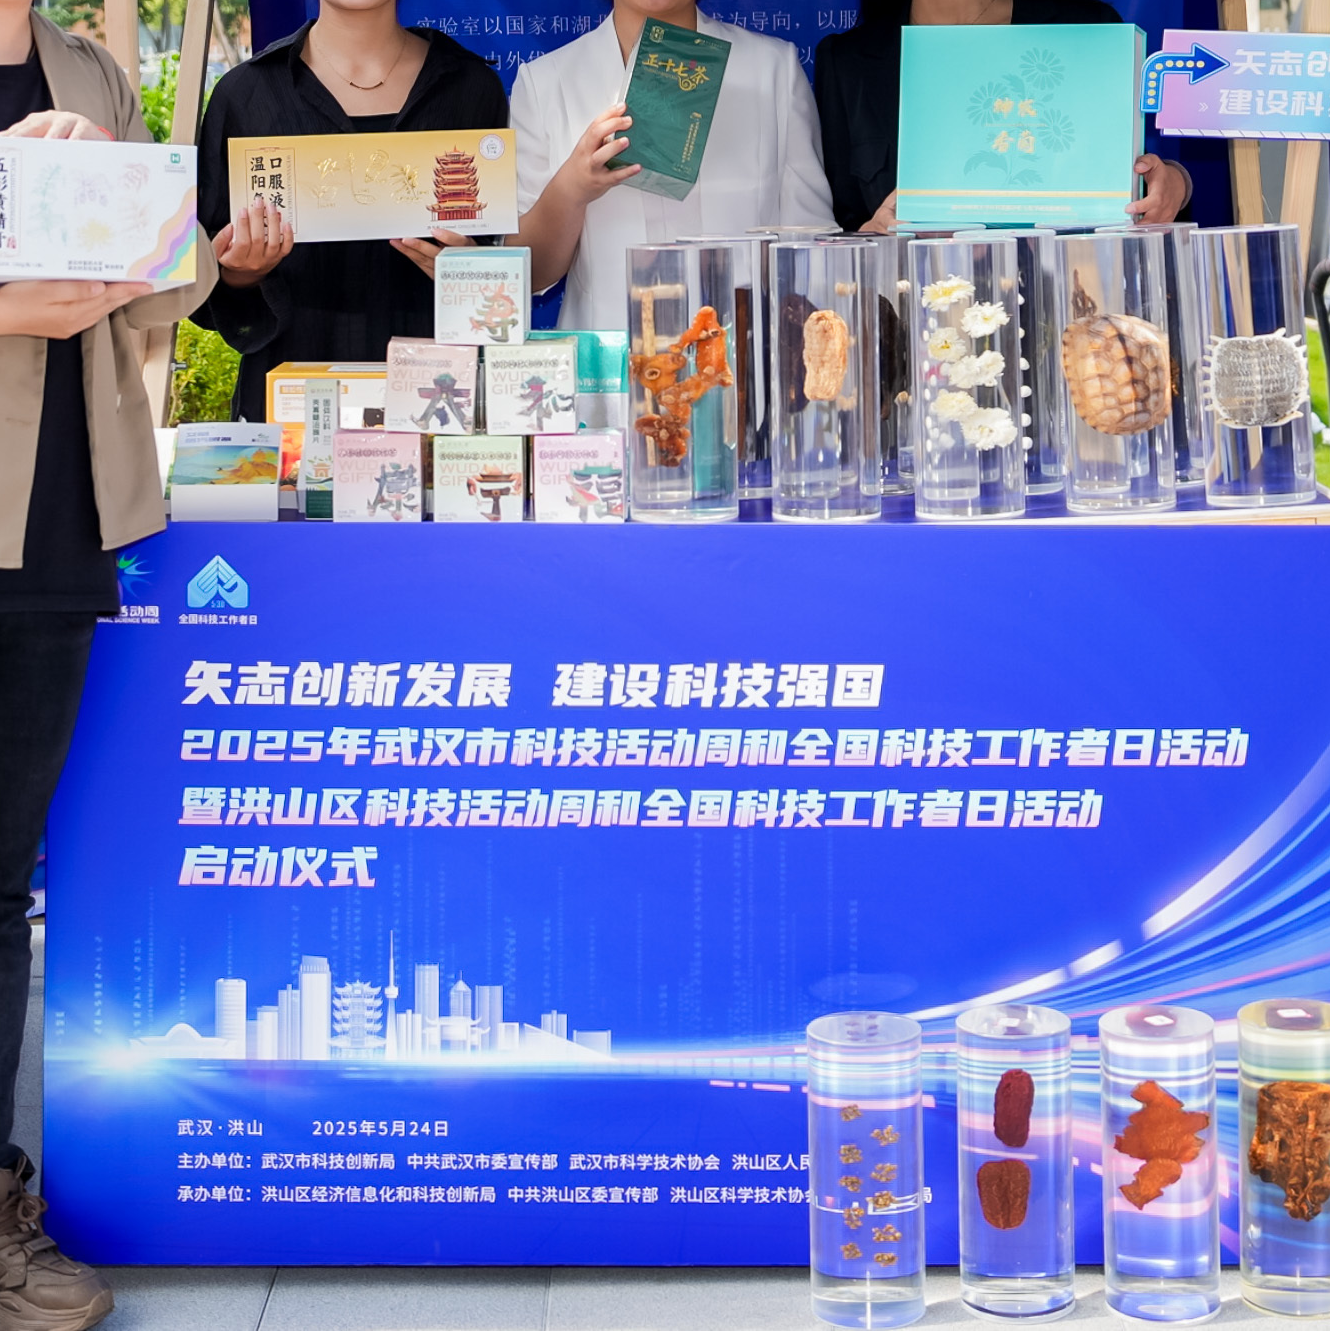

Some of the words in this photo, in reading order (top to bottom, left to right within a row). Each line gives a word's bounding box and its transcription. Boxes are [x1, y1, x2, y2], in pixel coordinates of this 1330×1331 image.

[177, 613, 259, 626] 全国科技工作者日
[180, 659, 514, 709] 矢志创新发展
[551, 660, 885, 710] 建设科技强国
[179, 726, 1249, 768] 2025年武汉市科技活动周和全国科技工作者日活动
[178, 786, 1103, 829] 暨洪山区科技活动周和全国科技工作者日活动
[178, 845, 378, 888] 启动仪式
[312, 1119, 450, 1137] 2025年5月24日
[177, 1152, 396, 1171] 主办单位：武汉市科技创新局
[406, 1152, 559, 1172] 中共武汉市委宣传部
[568, 1153, 721, 1172] 武汉市科学技术协会
[177, 1185, 496, 1204] 承办单位：洪山区经济信息化和科技创新局
[507, 1185, 659, 1204] 中共洪山区委宣传部
